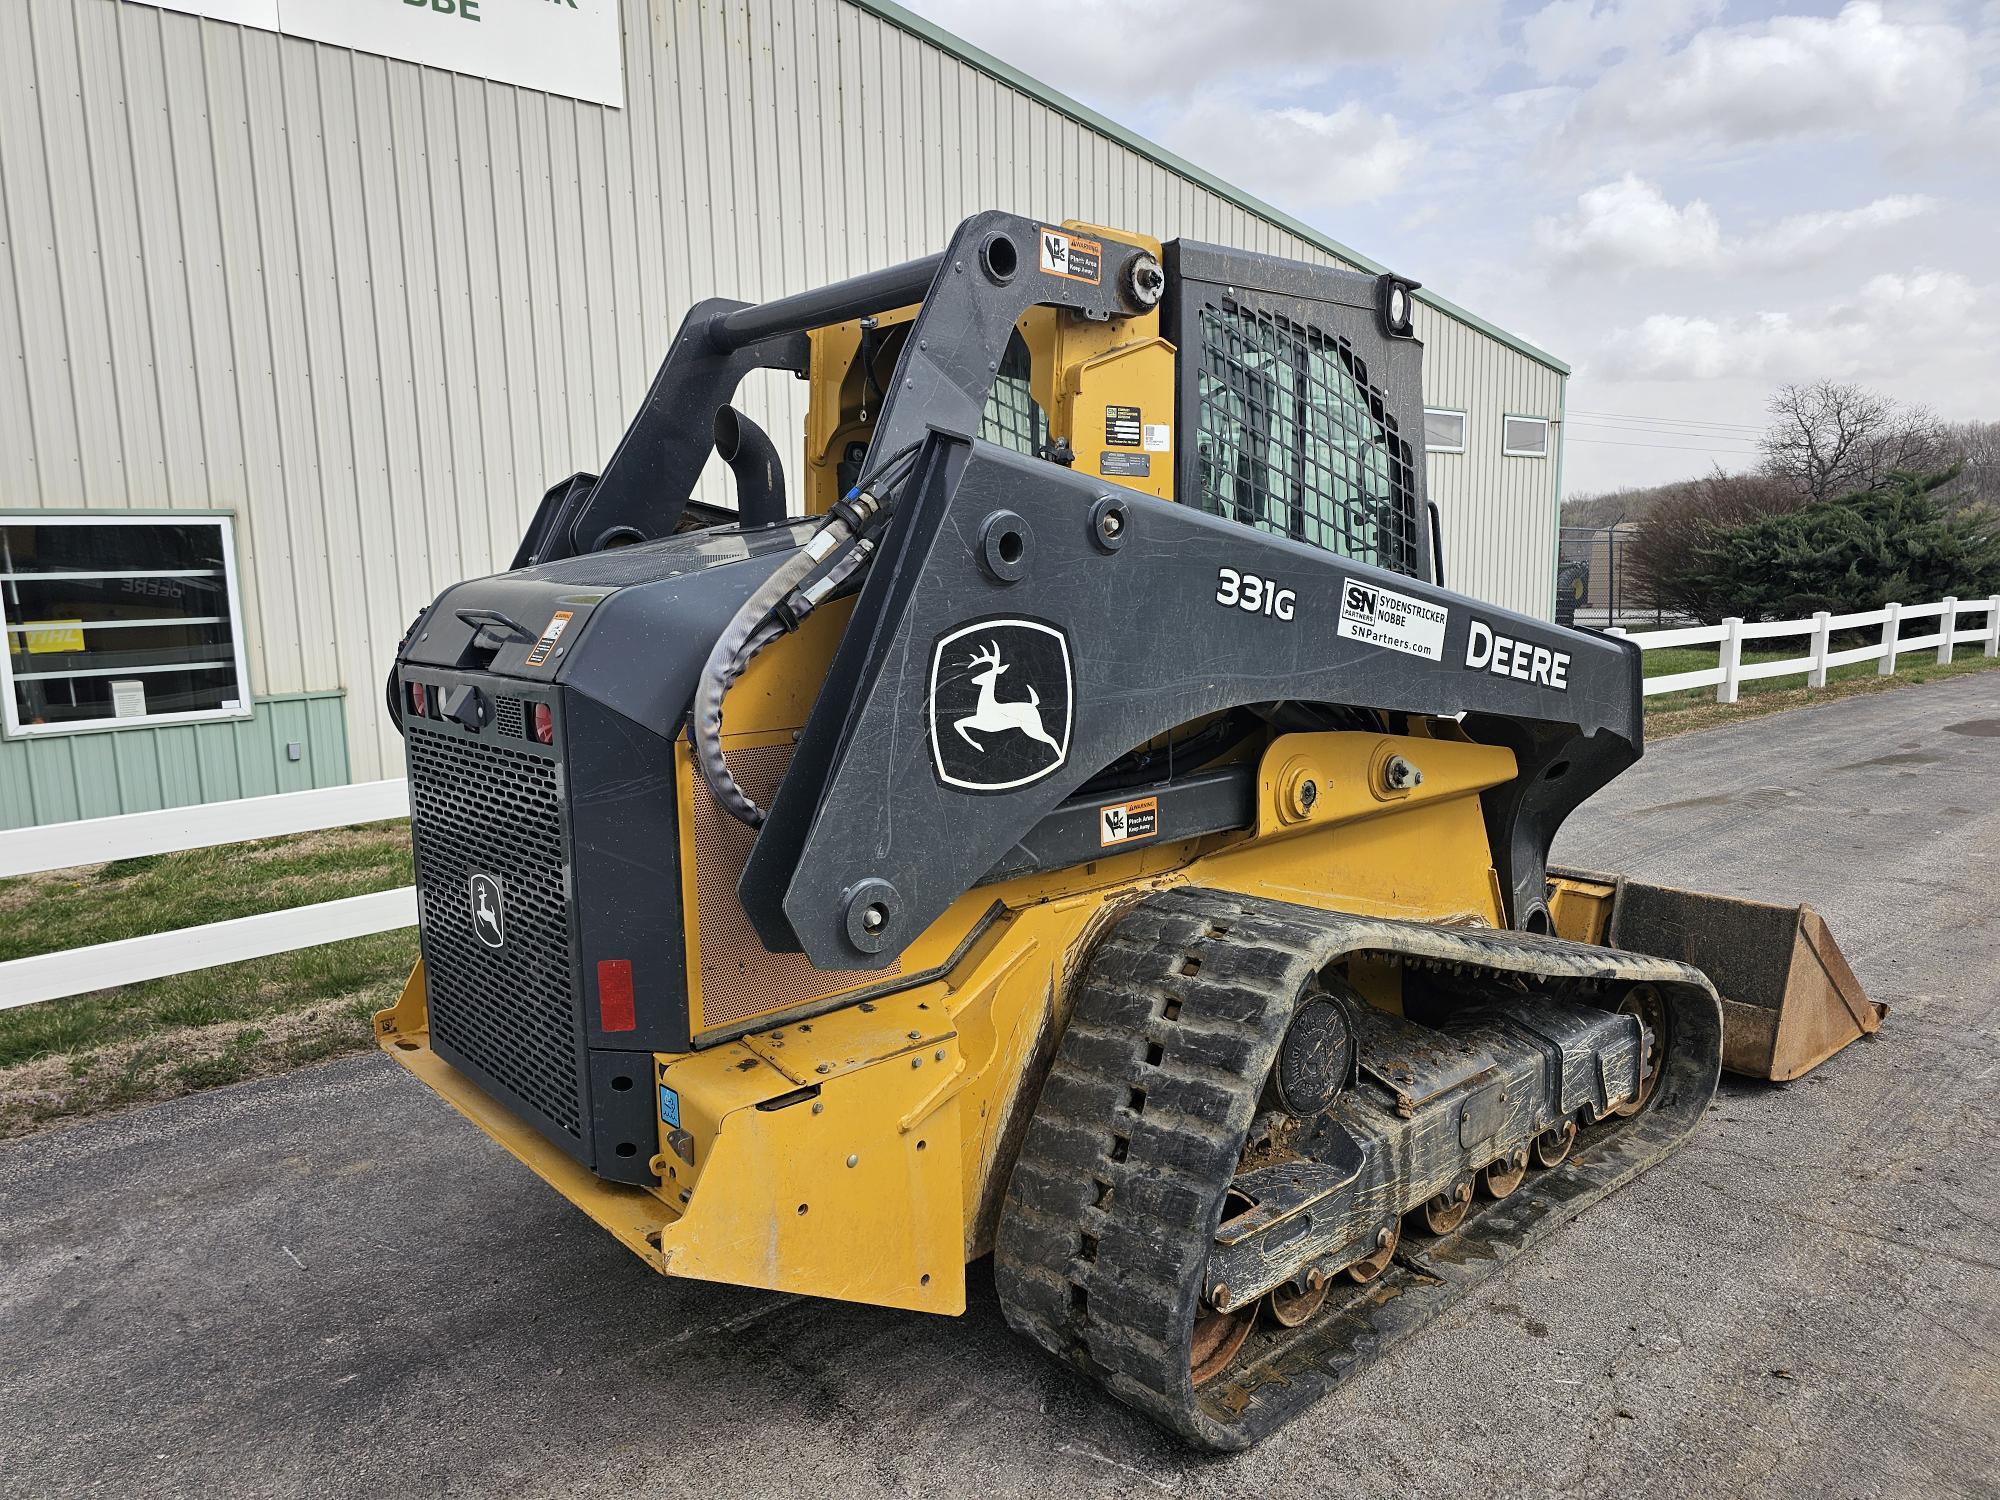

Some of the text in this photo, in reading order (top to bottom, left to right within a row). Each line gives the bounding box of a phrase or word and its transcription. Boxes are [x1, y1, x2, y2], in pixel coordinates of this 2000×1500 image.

[1070, 264, 1081, 272] Keep
[1085, 259, 1097, 267] Area
[1215, 568, 1296, 621] 331G
[1346, 587, 1376, 615] SN
[1344, 610, 1374, 622] PARTNERS
[1377, 610, 1406, 627] NOBBE
[1380, 596, 1446, 625] SYDENSTRICKER
[1351, 626, 1432, 655] SNPartners.com
[1466, 620, 1571, 690] DEERE
[1129, 817, 1142, 825] Pinch
